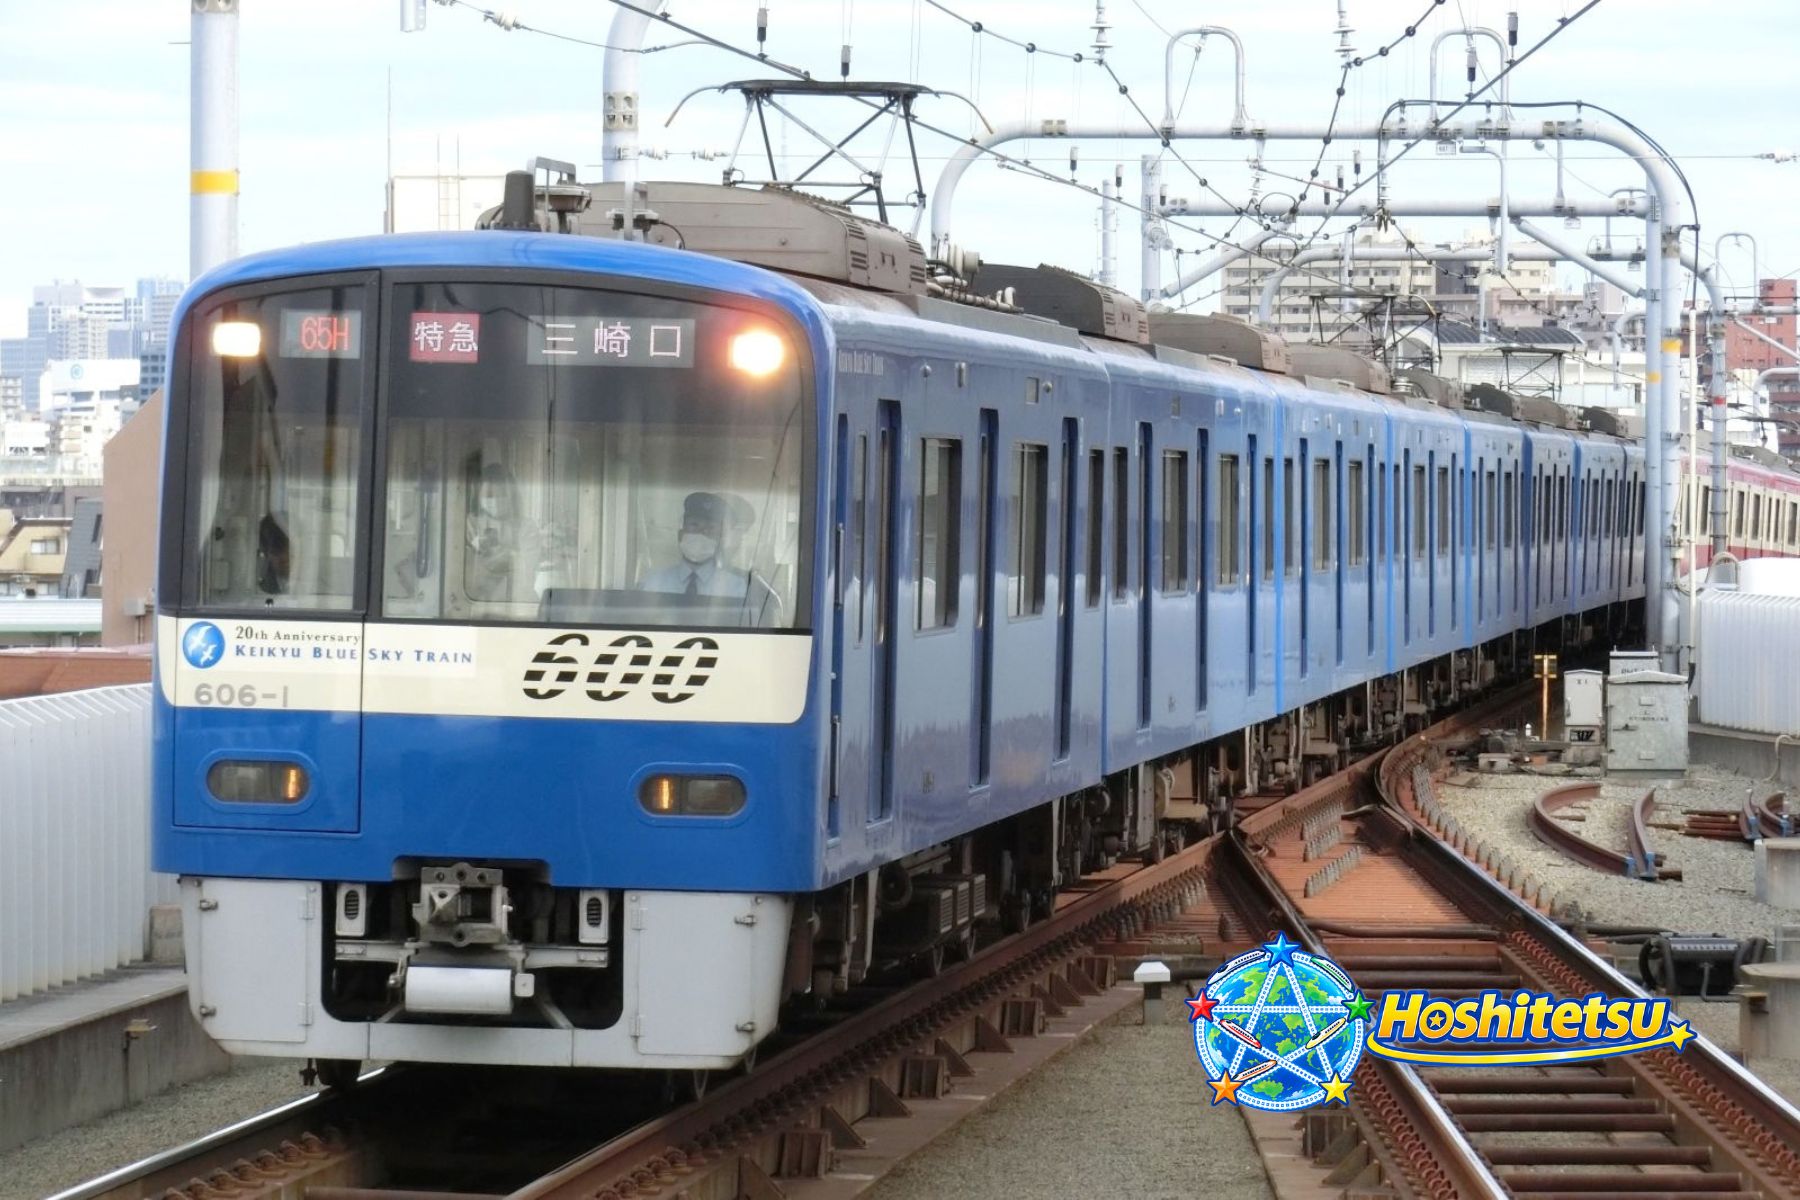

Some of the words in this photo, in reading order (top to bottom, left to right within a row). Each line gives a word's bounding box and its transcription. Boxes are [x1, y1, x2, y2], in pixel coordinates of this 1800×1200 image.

[300, 316, 350, 352] 65H
[414, 321, 478, 352] 特急
[541, 321, 682, 358] 三崎口
[235, 625, 268, 641] 20th
[273, 630, 362, 646] Anniversary
[235, 645, 301, 658] KEIKYU
[313, 647, 358, 660] BLUE
[368, 648, 404, 662] SKY
[415, 650, 473, 664] TRAIN
[522, 633, 719, 704] 600
[194, 682, 289, 708] 606-1
